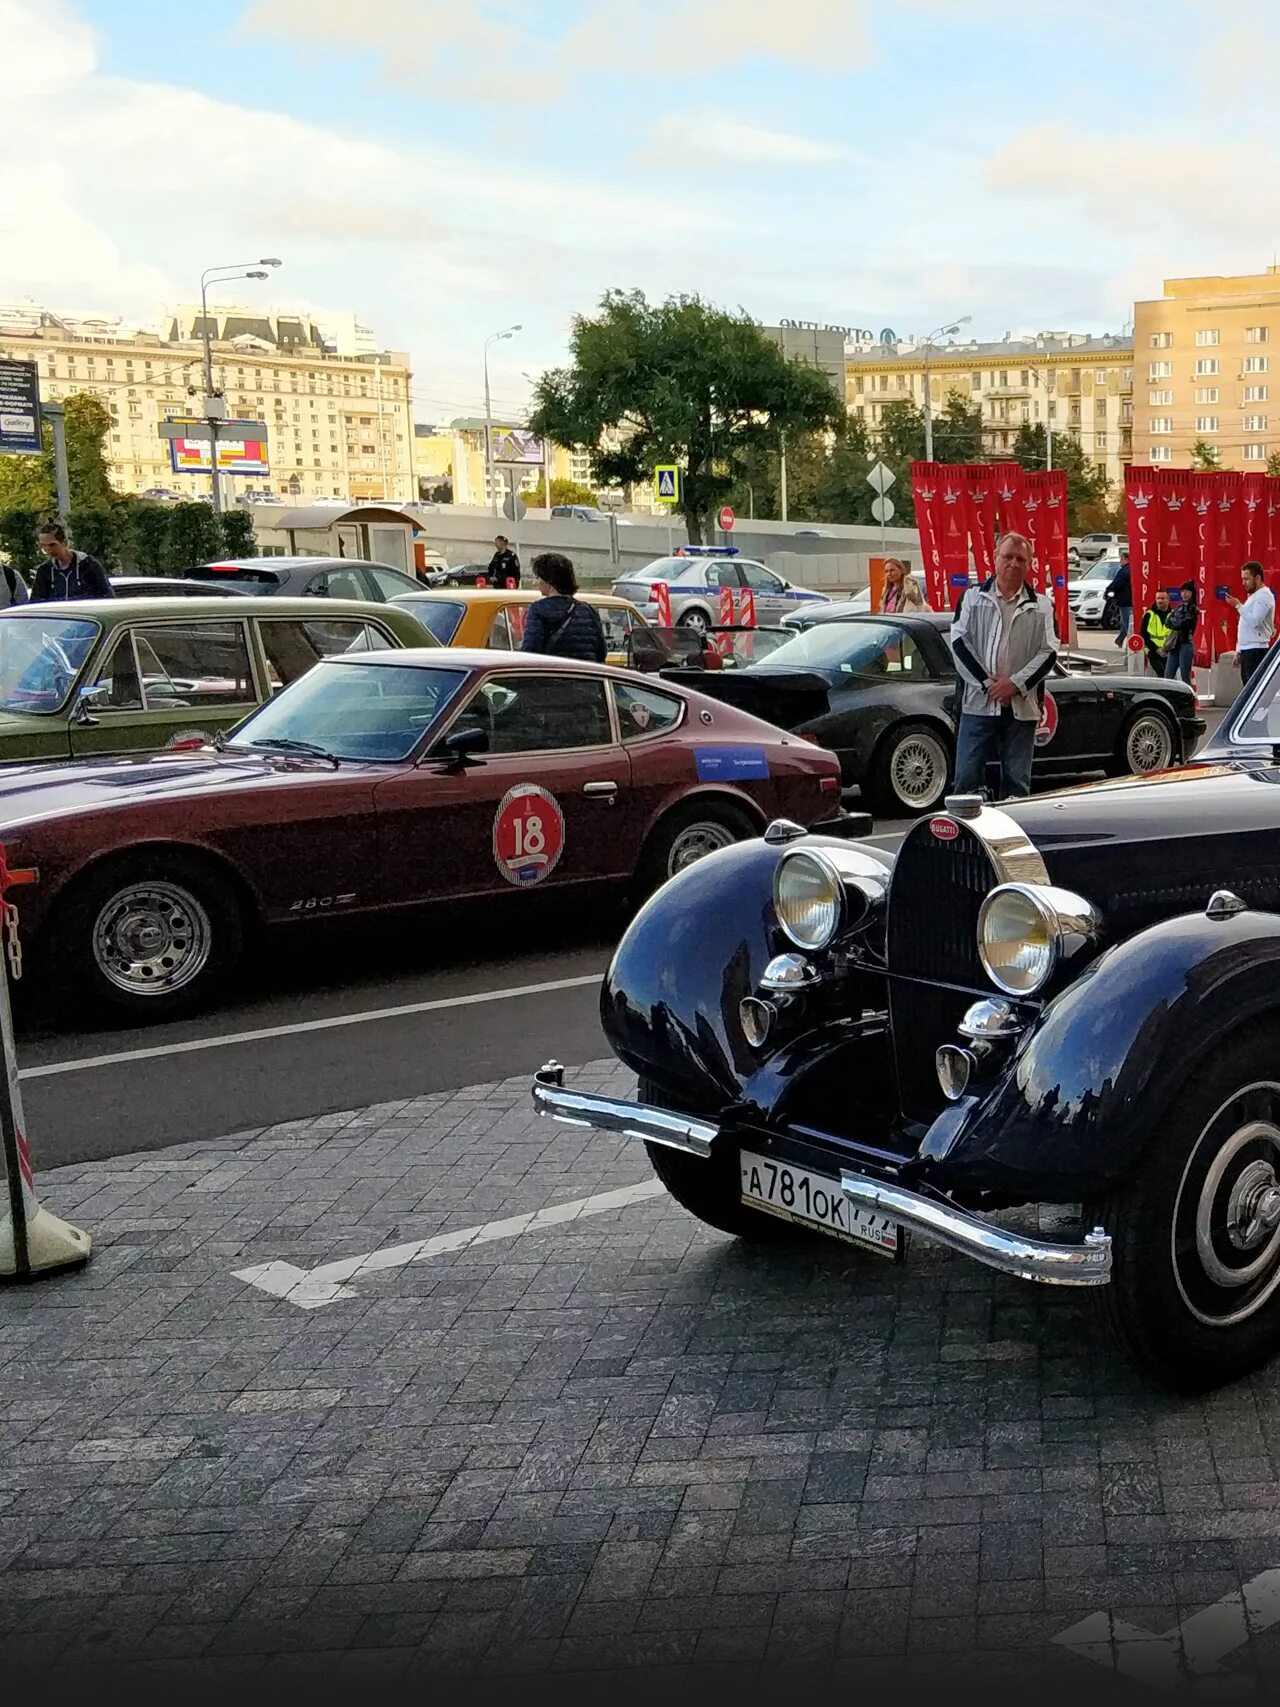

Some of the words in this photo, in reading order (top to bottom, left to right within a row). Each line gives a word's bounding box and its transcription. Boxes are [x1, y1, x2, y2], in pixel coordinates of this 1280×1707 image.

[1028, 518, 1039, 589] СТАР
[513, 816, 545, 855] 18
[931, 824, 956, 835] BUGATTI
[860, 1224, 881, 1241] RUS
